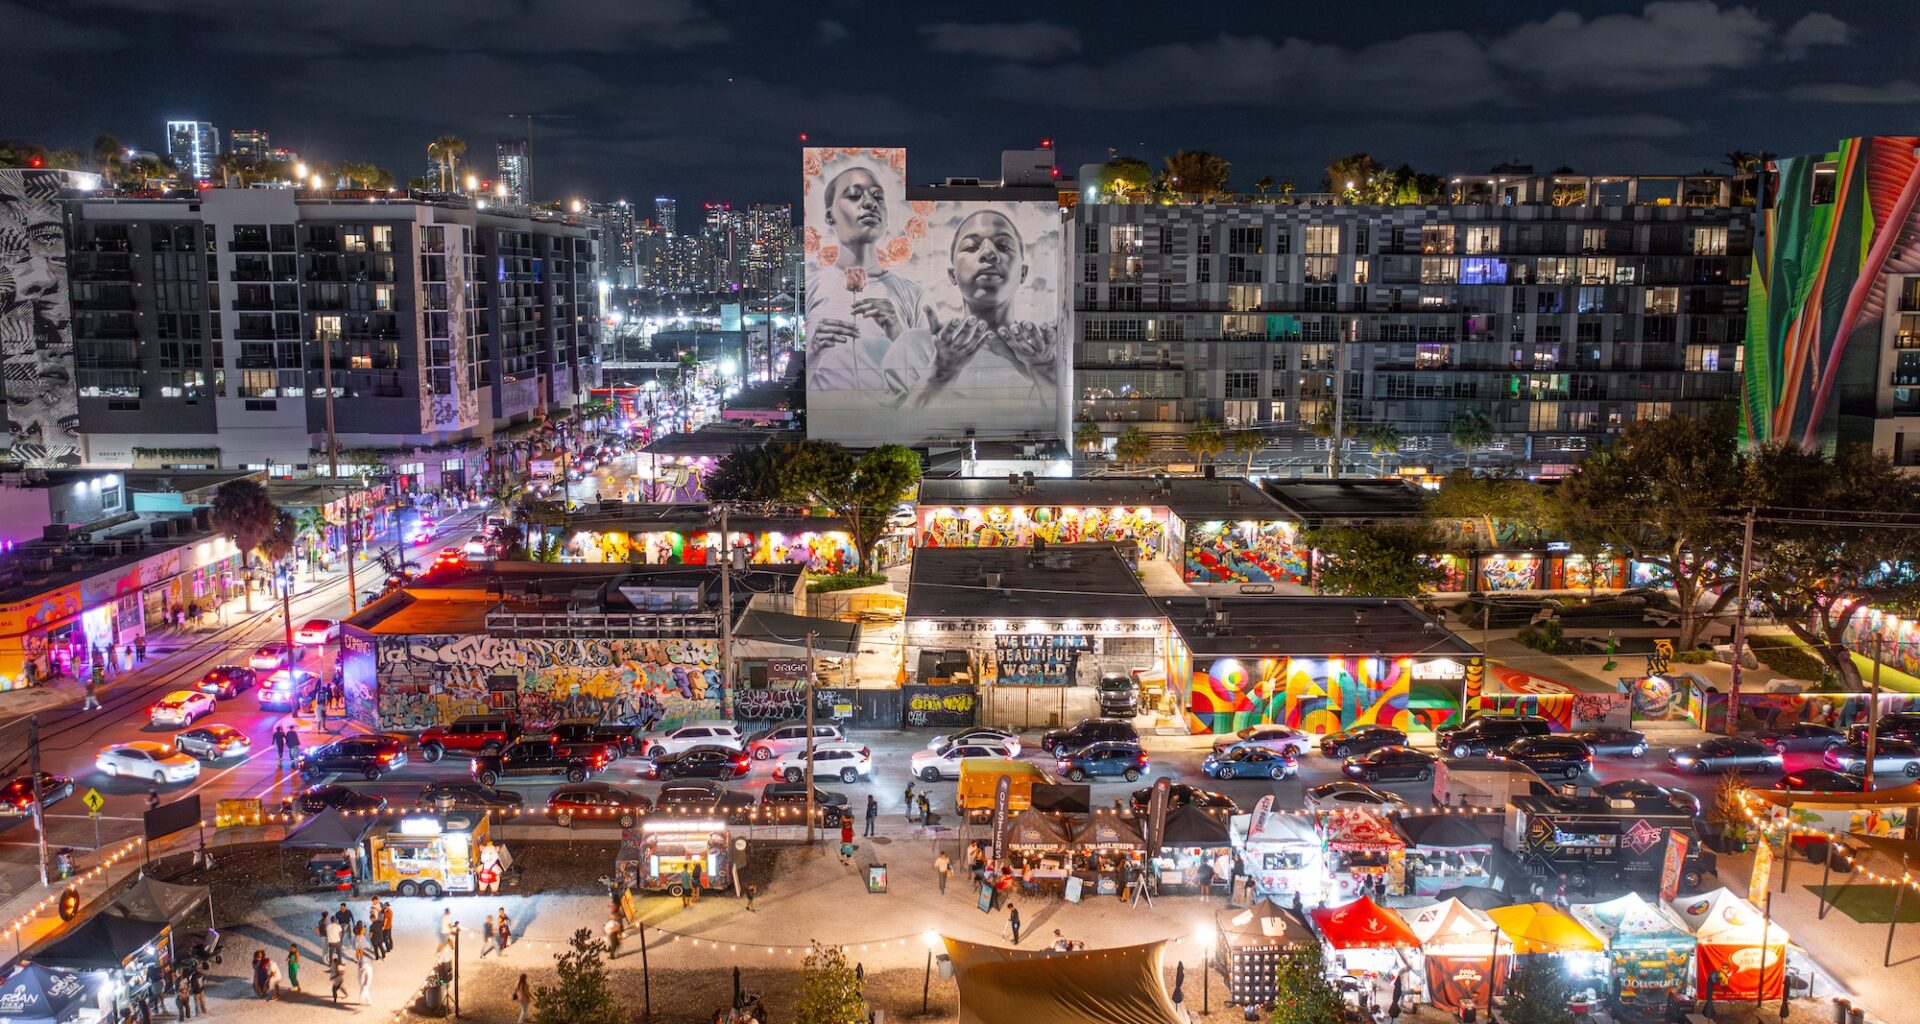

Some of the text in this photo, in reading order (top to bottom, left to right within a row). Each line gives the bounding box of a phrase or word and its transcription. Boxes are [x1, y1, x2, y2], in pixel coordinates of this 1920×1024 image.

[1006, 623, 1019, 632] IS
[1132, 623, 1162, 632] NOW
[997, 635, 1089, 648] WE LIVE IN A
[997, 648, 1072, 661] BEAUTIFUL
[1003, 663, 1067, 677] WORLD
[995, 792, 1006, 859] OYSTERS
[1621, 831, 1661, 848] EATS
